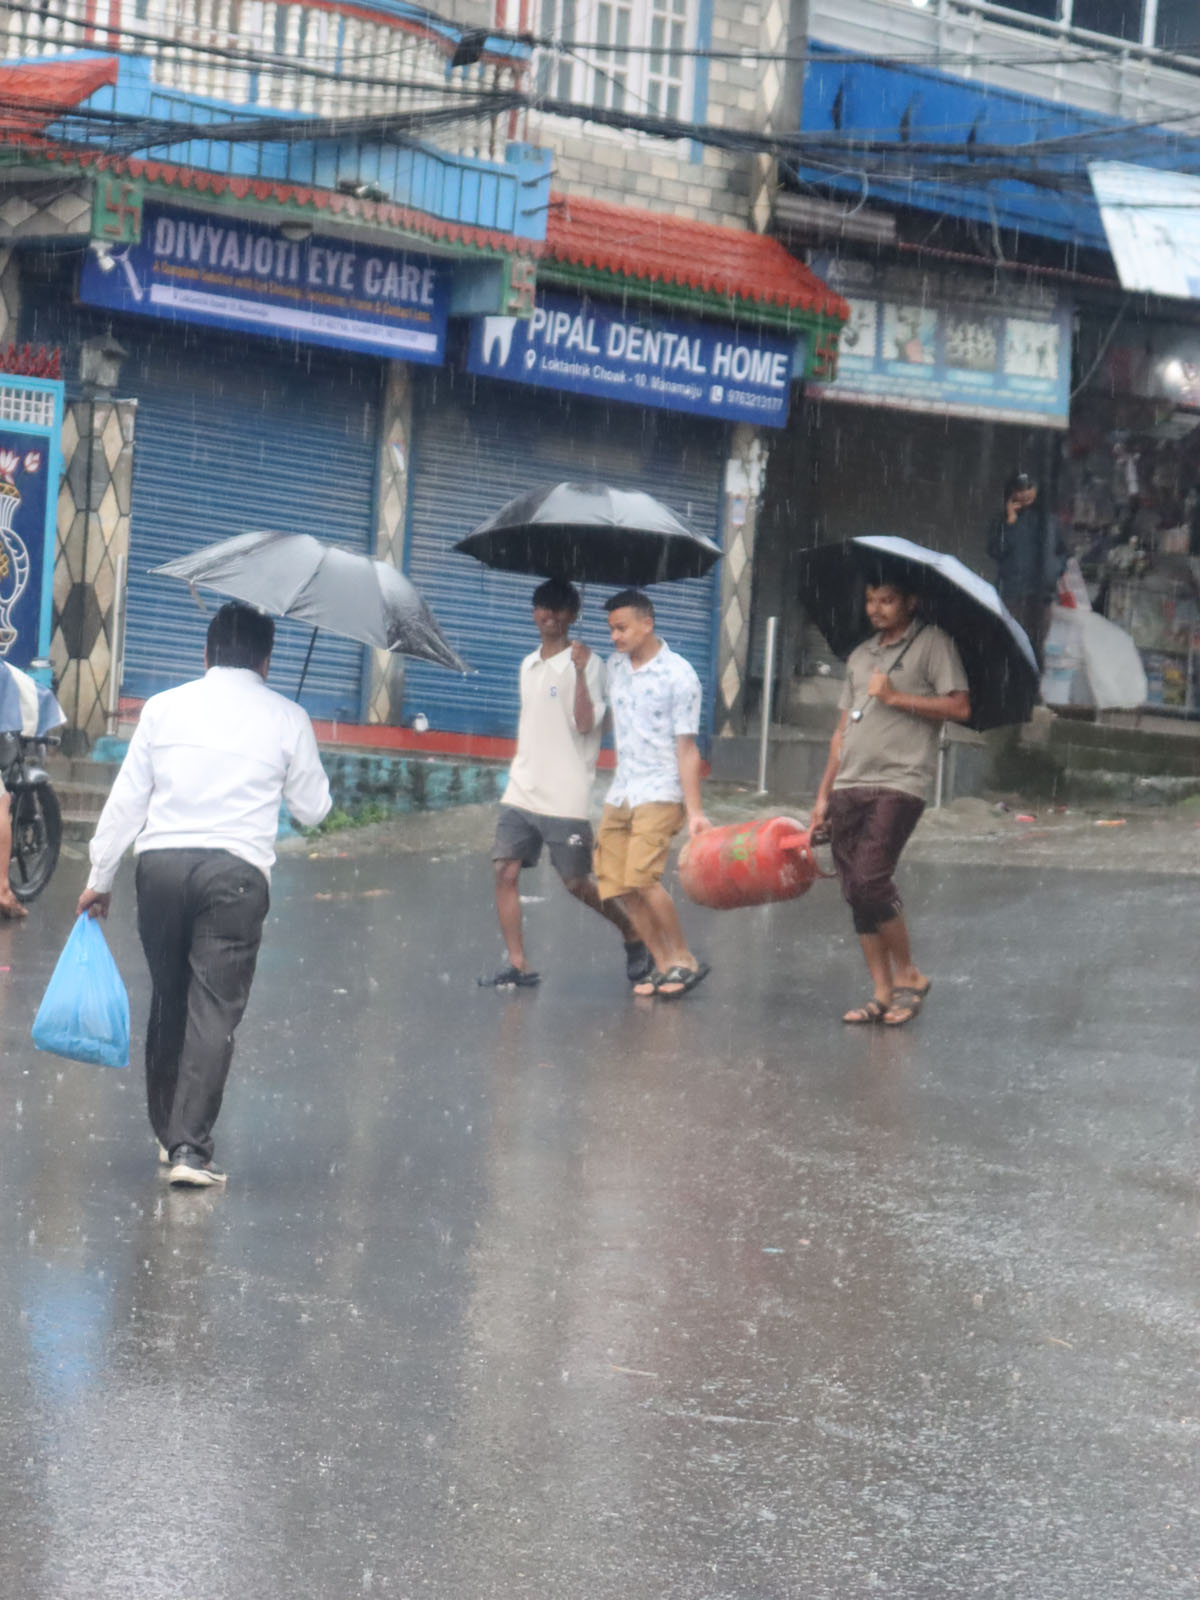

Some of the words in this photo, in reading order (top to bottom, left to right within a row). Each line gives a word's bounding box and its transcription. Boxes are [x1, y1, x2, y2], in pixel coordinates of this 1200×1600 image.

[154, 217, 299, 280] DIVYAJOTI
[307, 246, 356, 290] EYE
[363, 258, 436, 305] CARE
[528, 307, 600, 353] PIPAL
[606, 322, 706, 374] DENTAL
[712, 342, 789, 388] HOME
